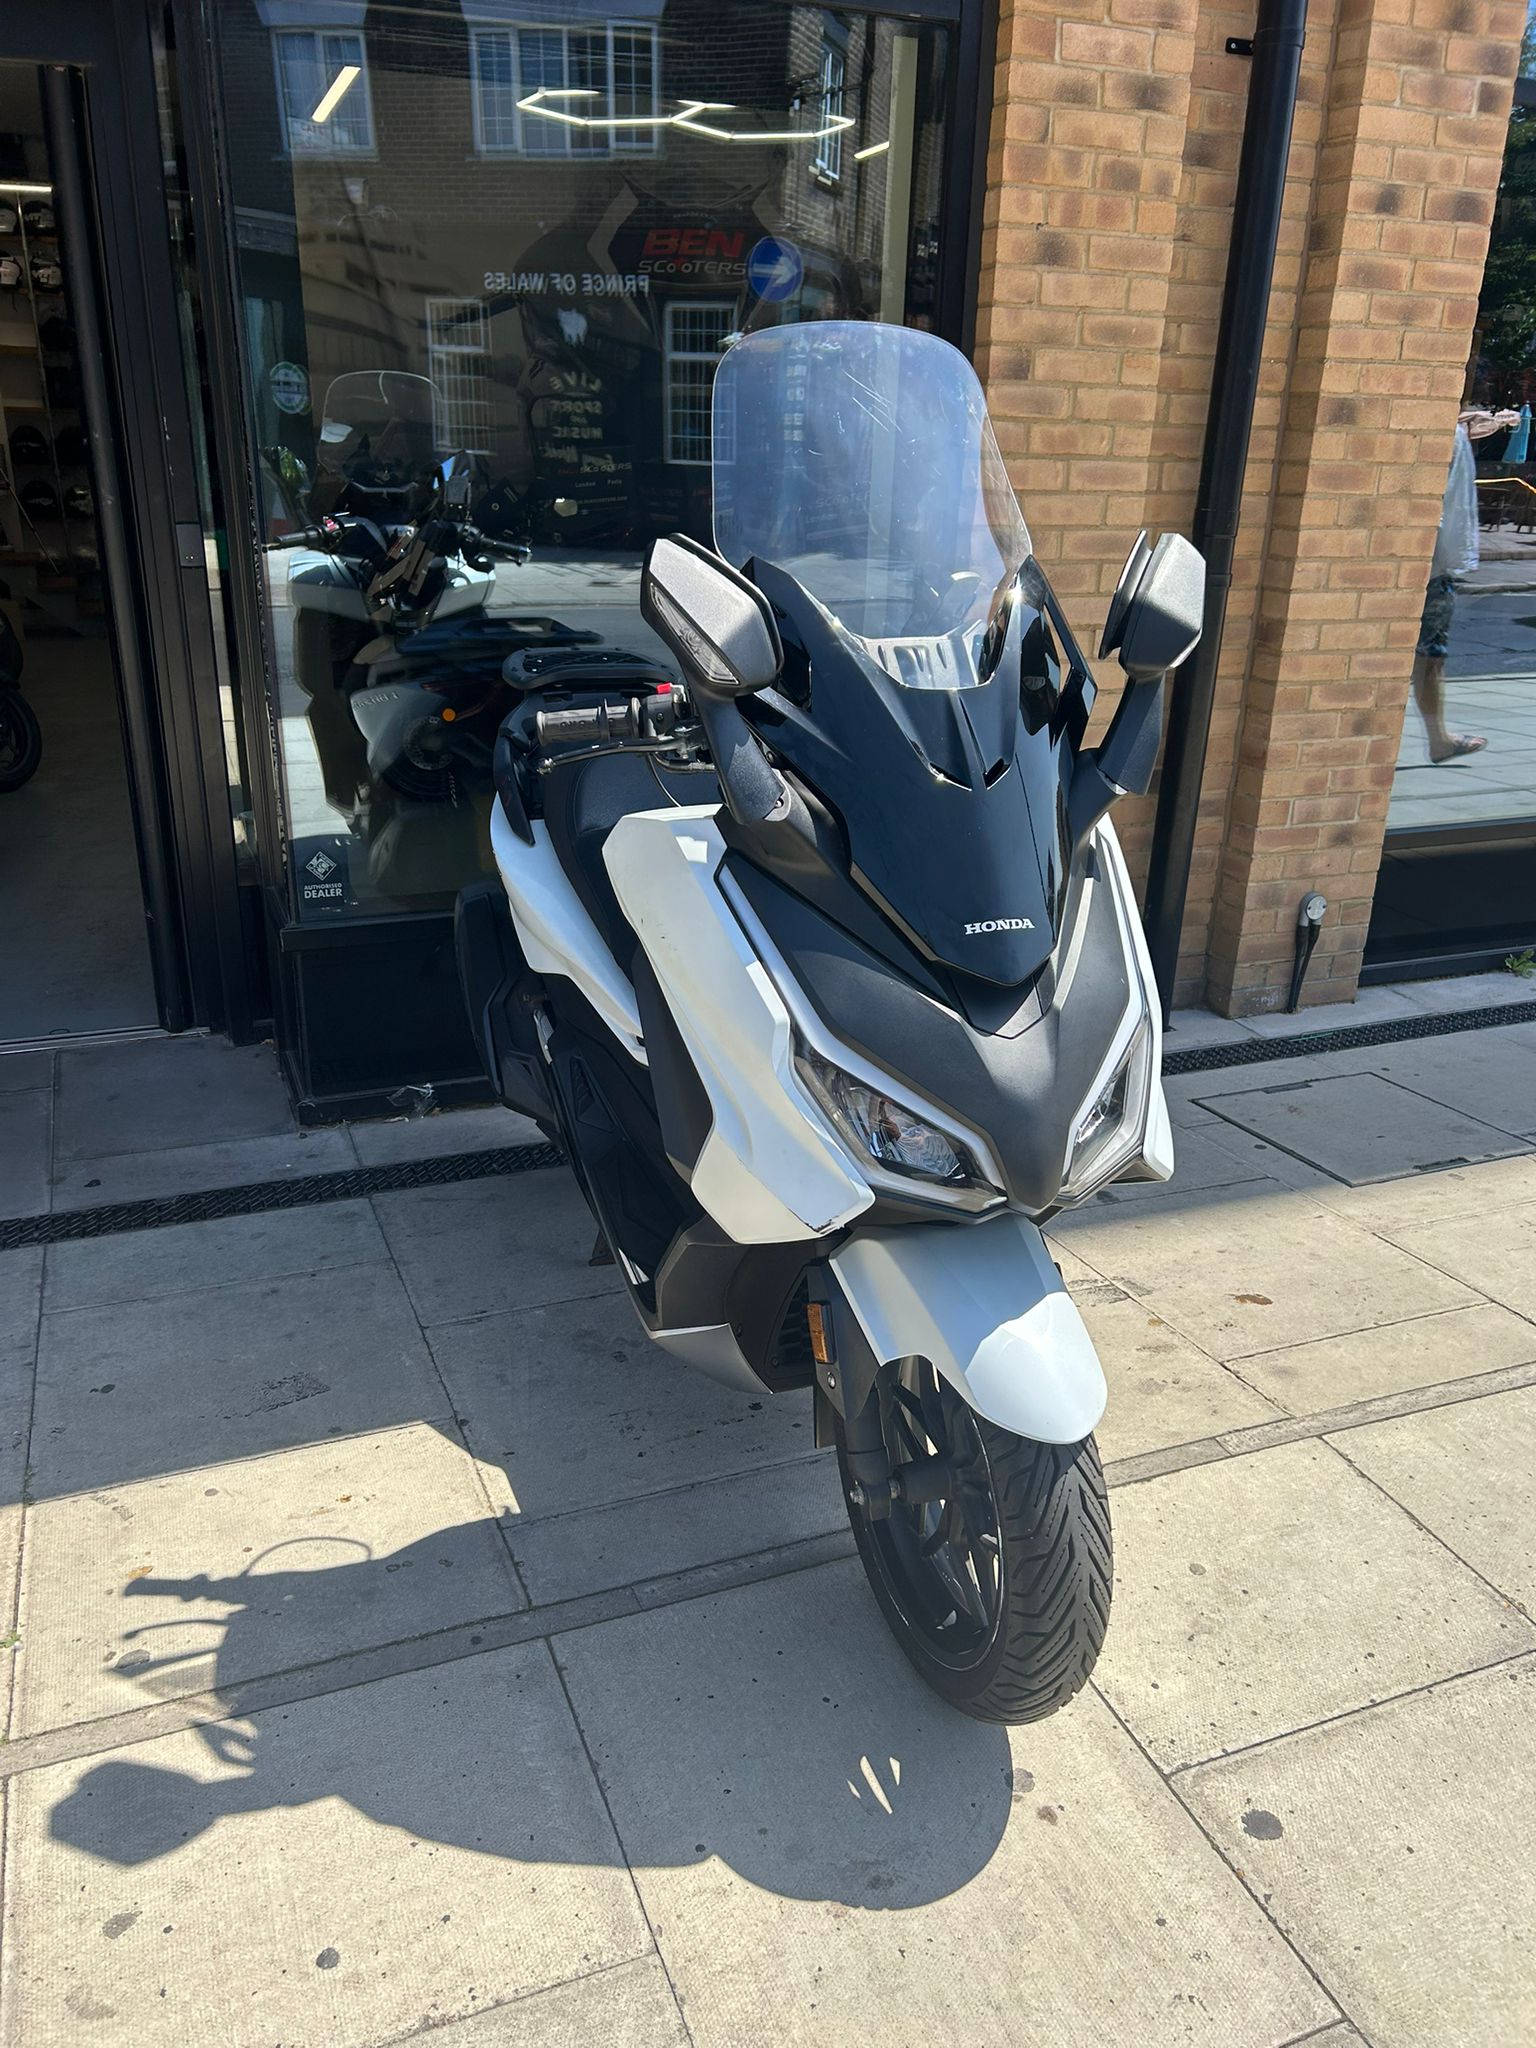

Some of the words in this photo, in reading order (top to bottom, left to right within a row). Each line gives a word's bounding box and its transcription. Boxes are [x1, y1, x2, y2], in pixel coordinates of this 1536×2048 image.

[642, 229, 745, 258] BEN
[304, 888, 343, 898] DEALER
[964, 918, 1035, 935] HONDA
